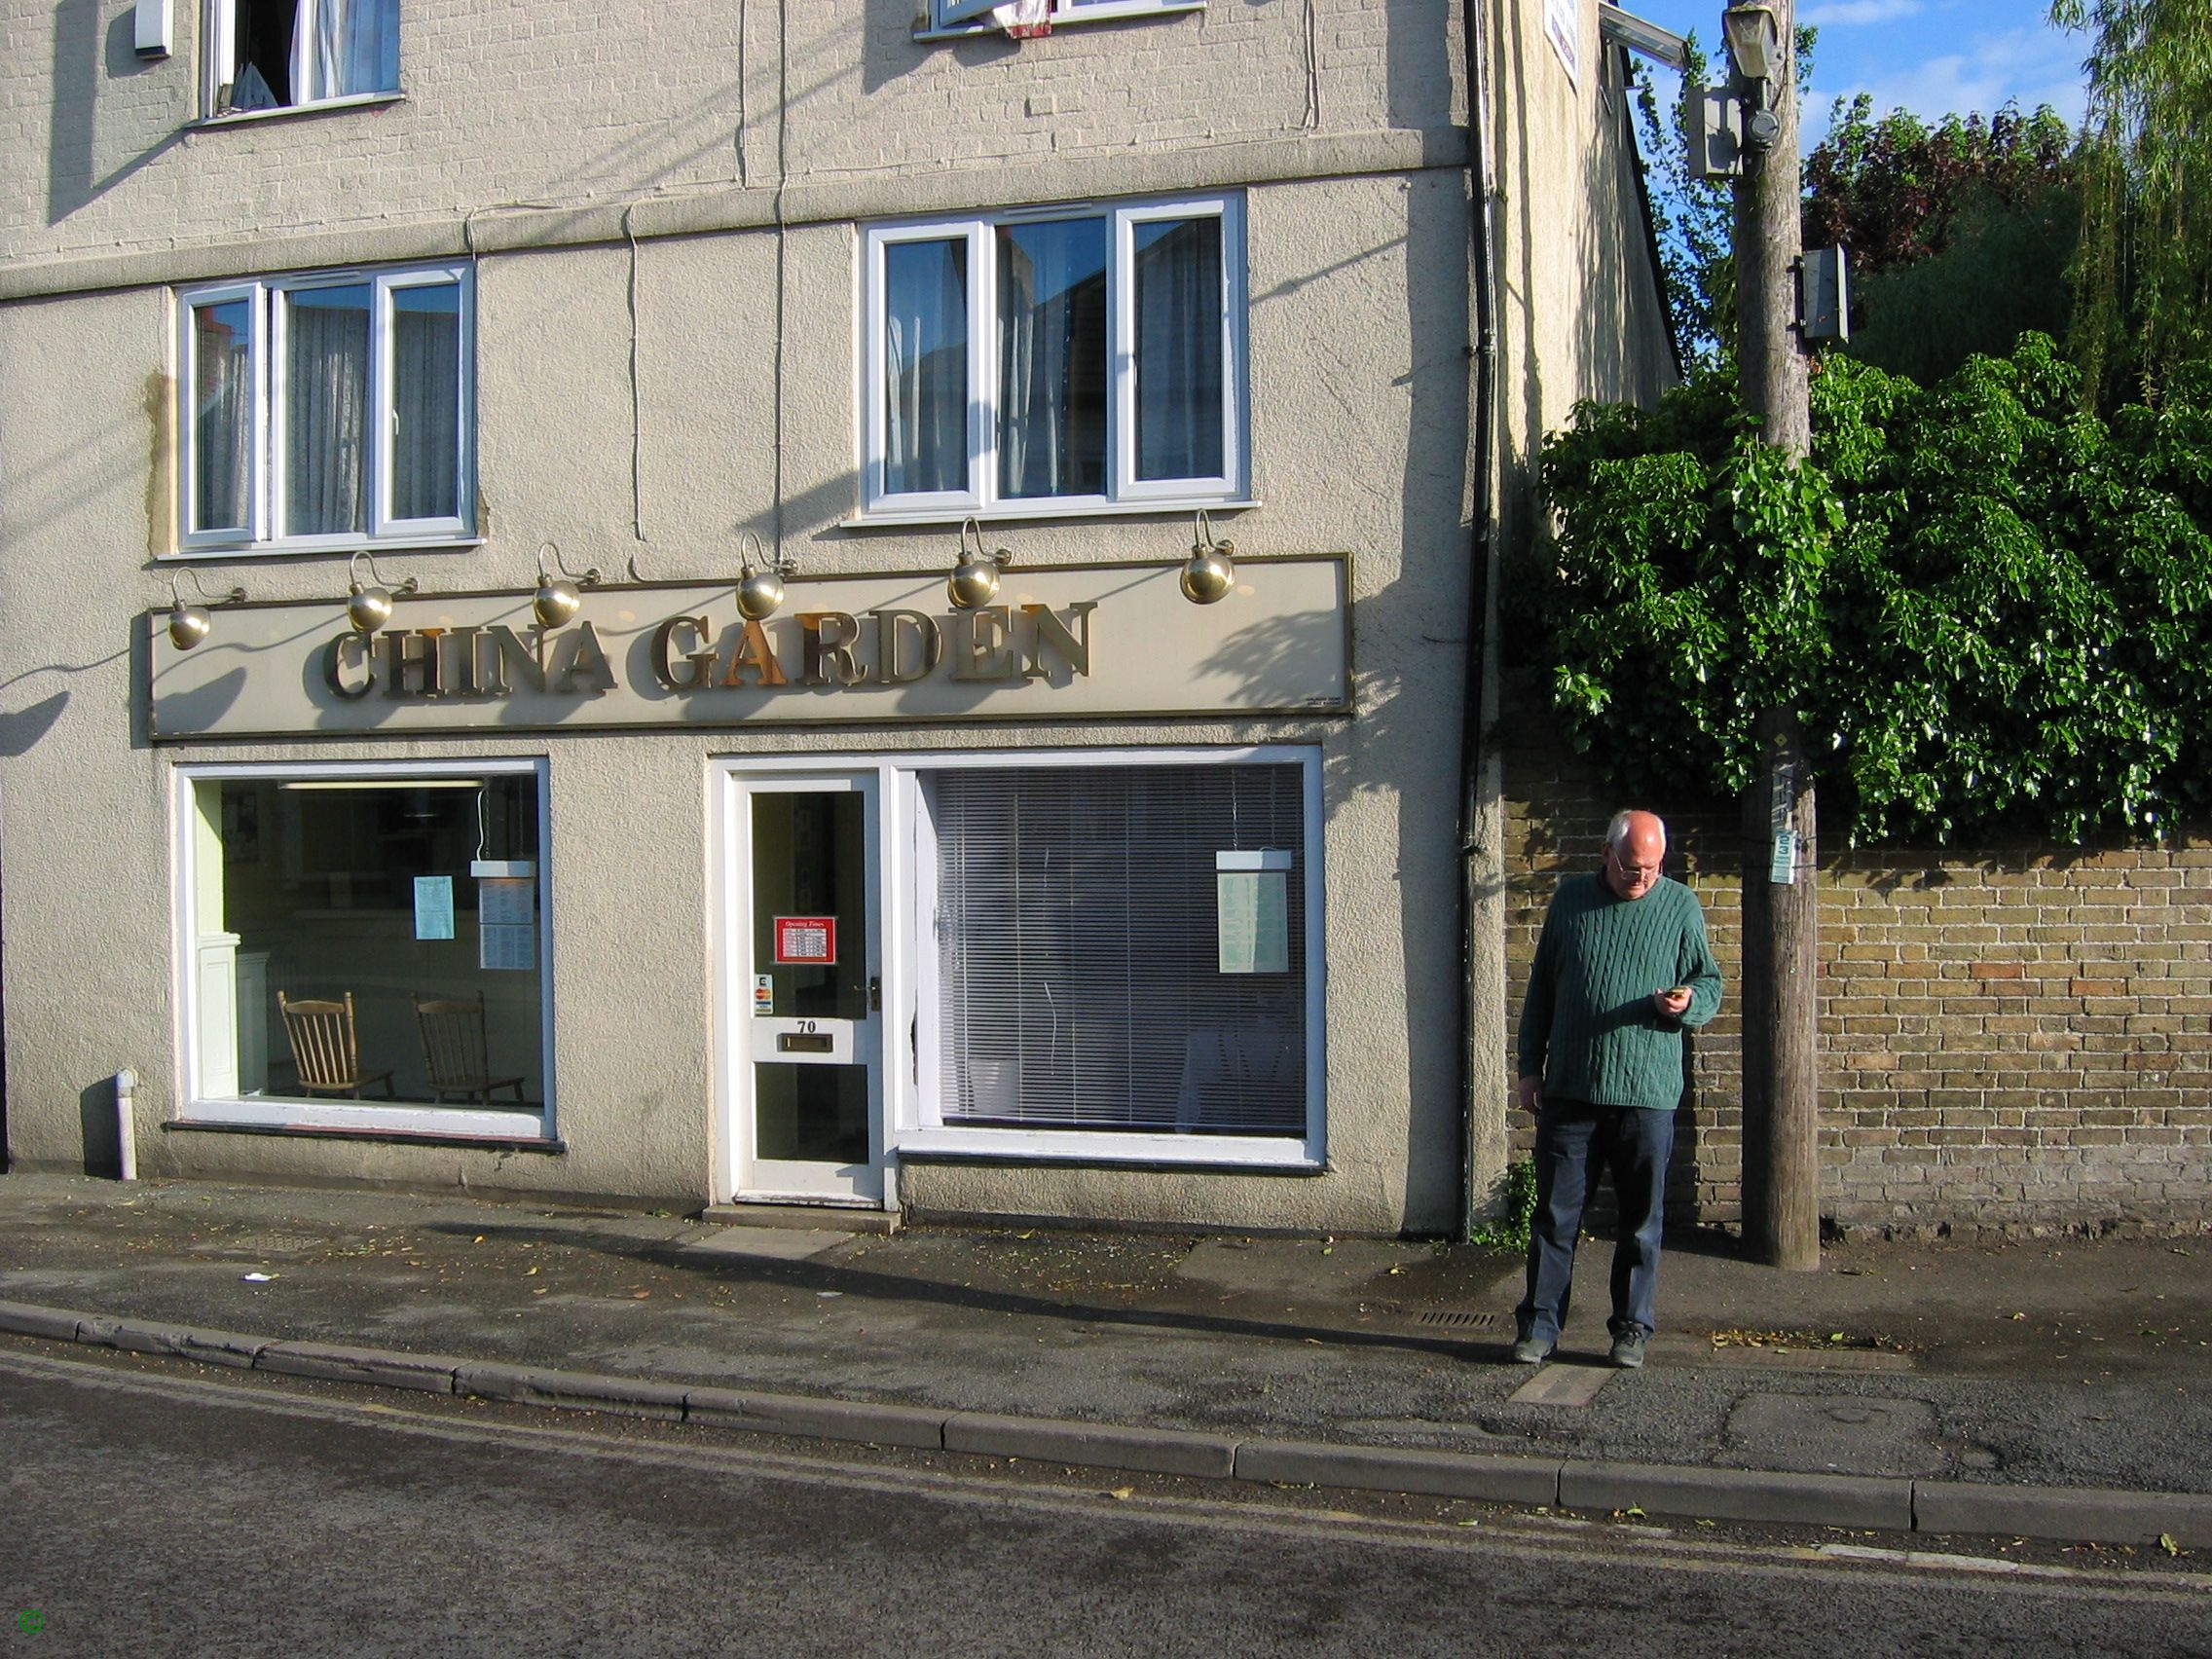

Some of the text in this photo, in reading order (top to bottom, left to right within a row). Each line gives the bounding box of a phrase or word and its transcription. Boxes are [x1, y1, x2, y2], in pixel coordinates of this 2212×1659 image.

[323, 602, 1098, 699] CHINA GARDEN
[796, 1020, 816, 1033] 70
